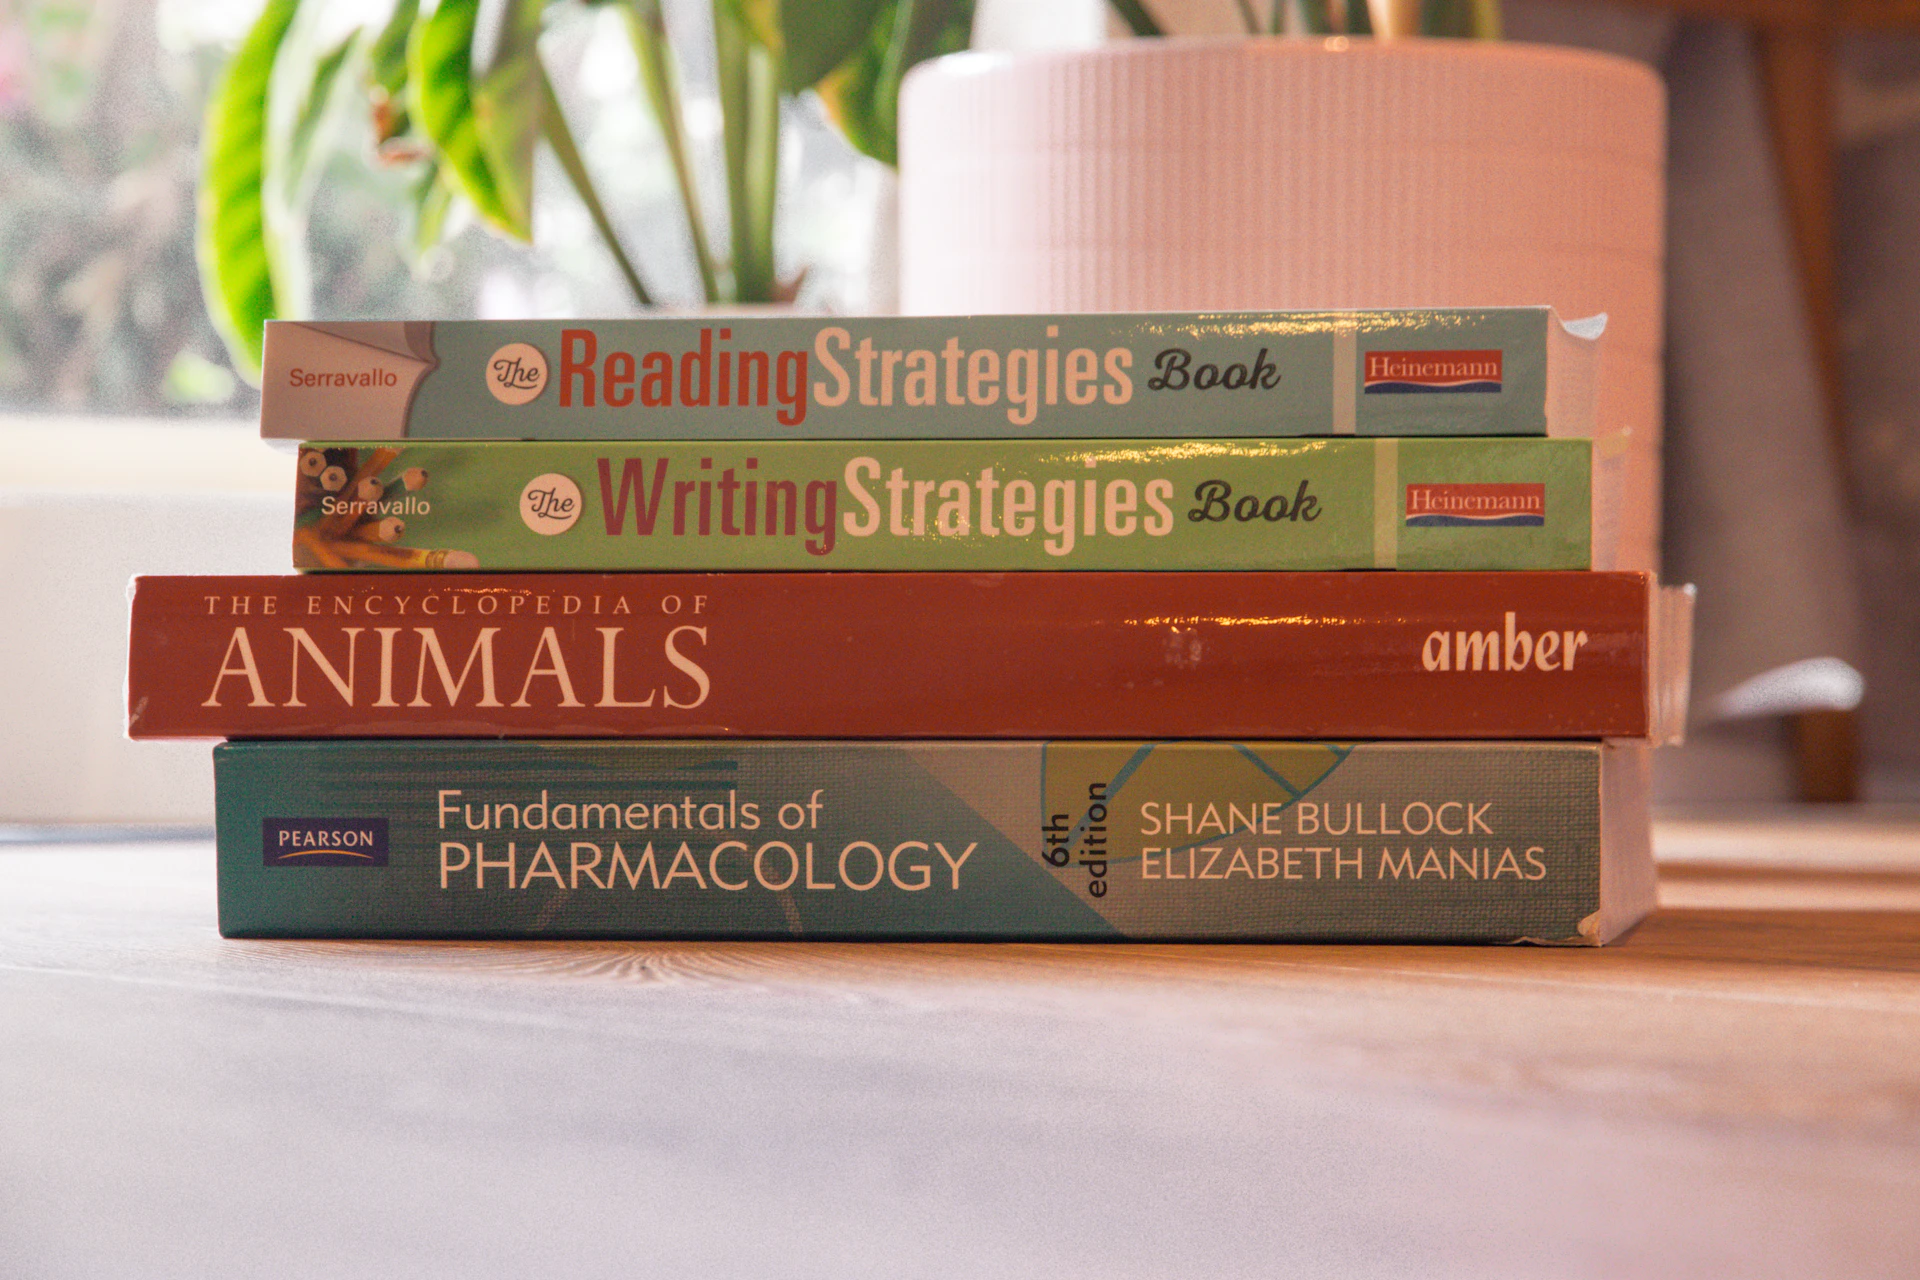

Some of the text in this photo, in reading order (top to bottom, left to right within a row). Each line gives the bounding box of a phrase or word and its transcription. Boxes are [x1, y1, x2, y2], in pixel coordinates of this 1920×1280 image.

[289, 368, 397, 388] Serravallo
[493, 357, 540, 390] The
[1147, 348, 1281, 391] Book
[1367, 355, 1499, 378] Heinemann
[321, 496, 431, 516] Serravallo
[527, 487, 575, 520] The
[1187, 479, 1322, 523] Book
[1411, 489, 1541, 512] Heinemann
[203, 594, 708, 615] THE ENCYCLOPEDIA OF
[1422, 611, 1588, 672] amber
[201, 625, 711, 709] ANIMALS
[438, 788, 824, 830] Fundamentals of
[1140, 801, 1494, 836] SHANE BULLOCK
[278, 830, 374, 847] PEARSON
[1041, 812, 1069, 868] 6th
[1079, 781, 1107, 898] edition
[439, 840, 978, 892] PHARMACOLOGY
[1141, 846, 1547, 882] ELIZABETH MANIAS
